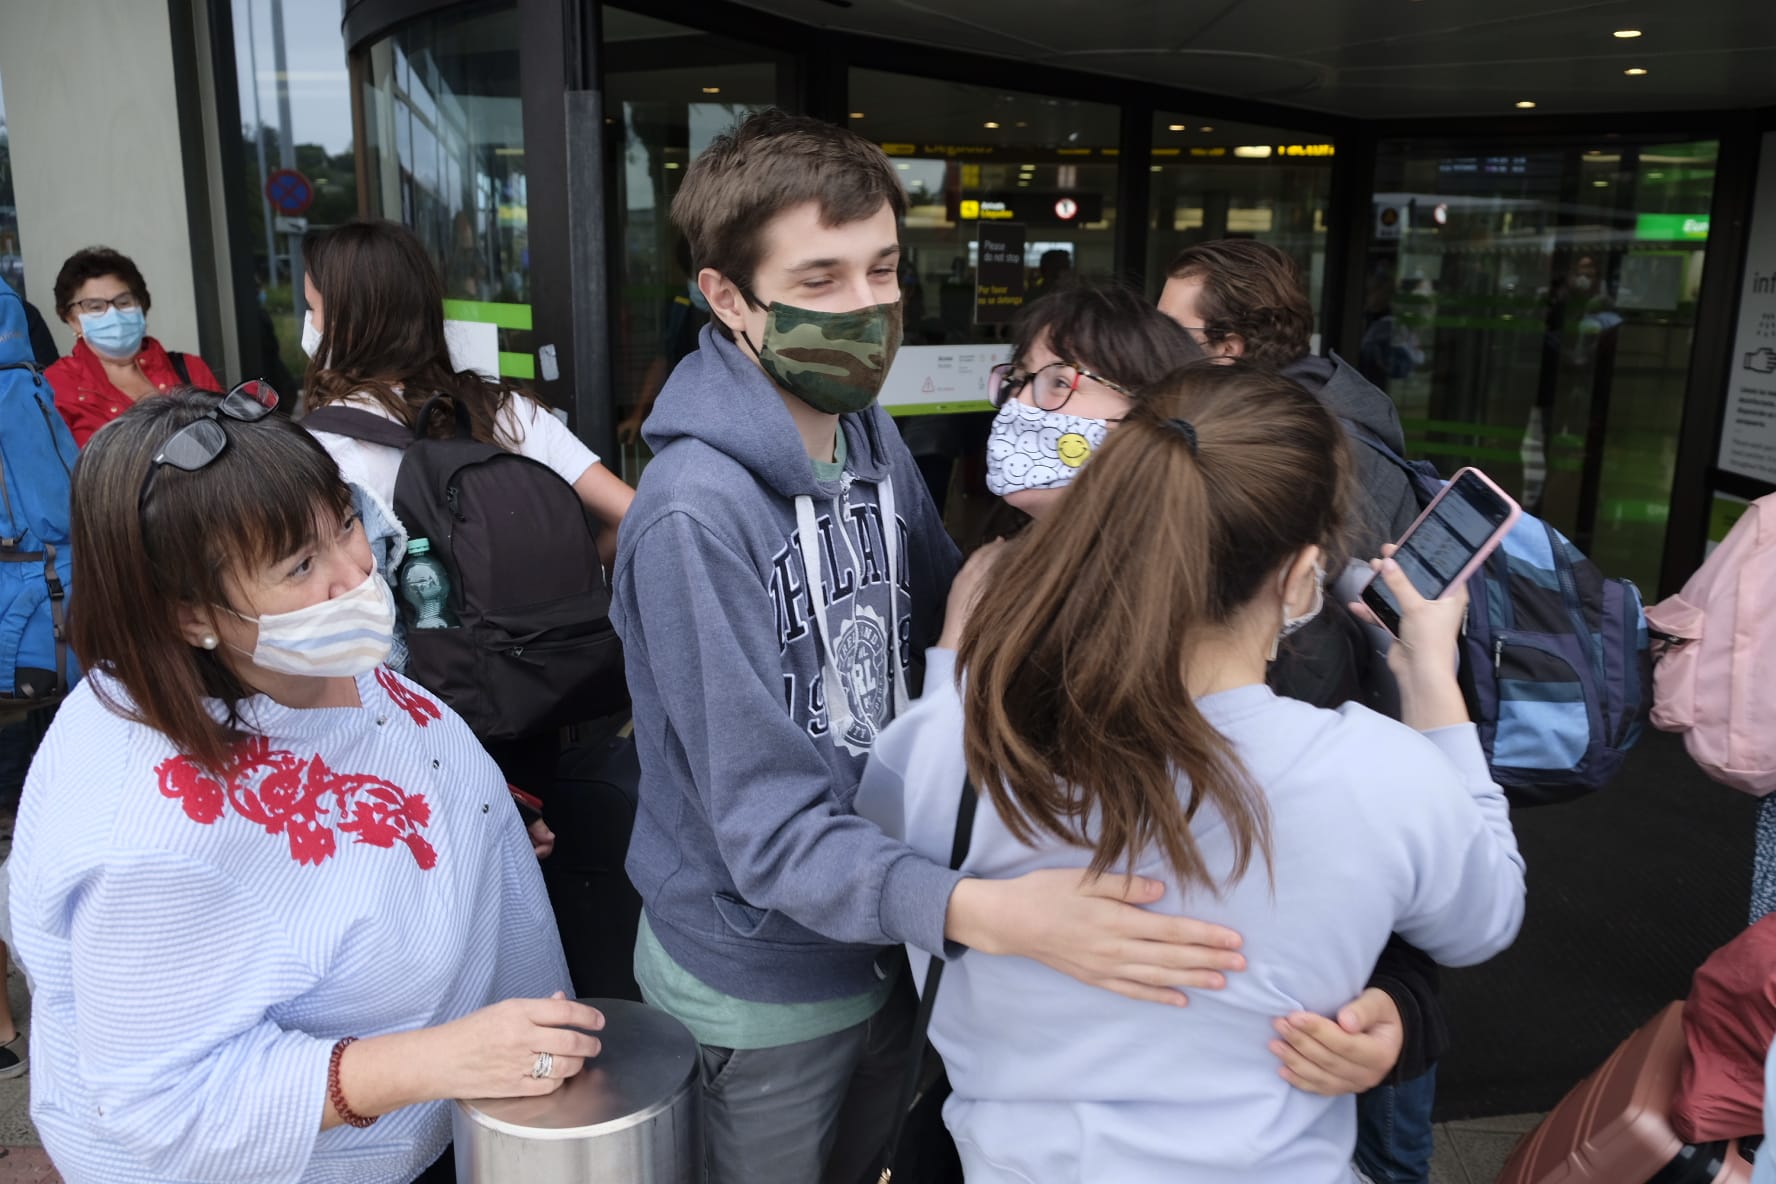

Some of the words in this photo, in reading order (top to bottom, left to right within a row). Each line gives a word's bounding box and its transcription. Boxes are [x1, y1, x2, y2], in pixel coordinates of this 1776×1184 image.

[984, 240, 1006, 251] Please
[984, 253, 993, 262] do
[994, 253, 1004, 262] not
[1006, 254, 1020, 263] stop
